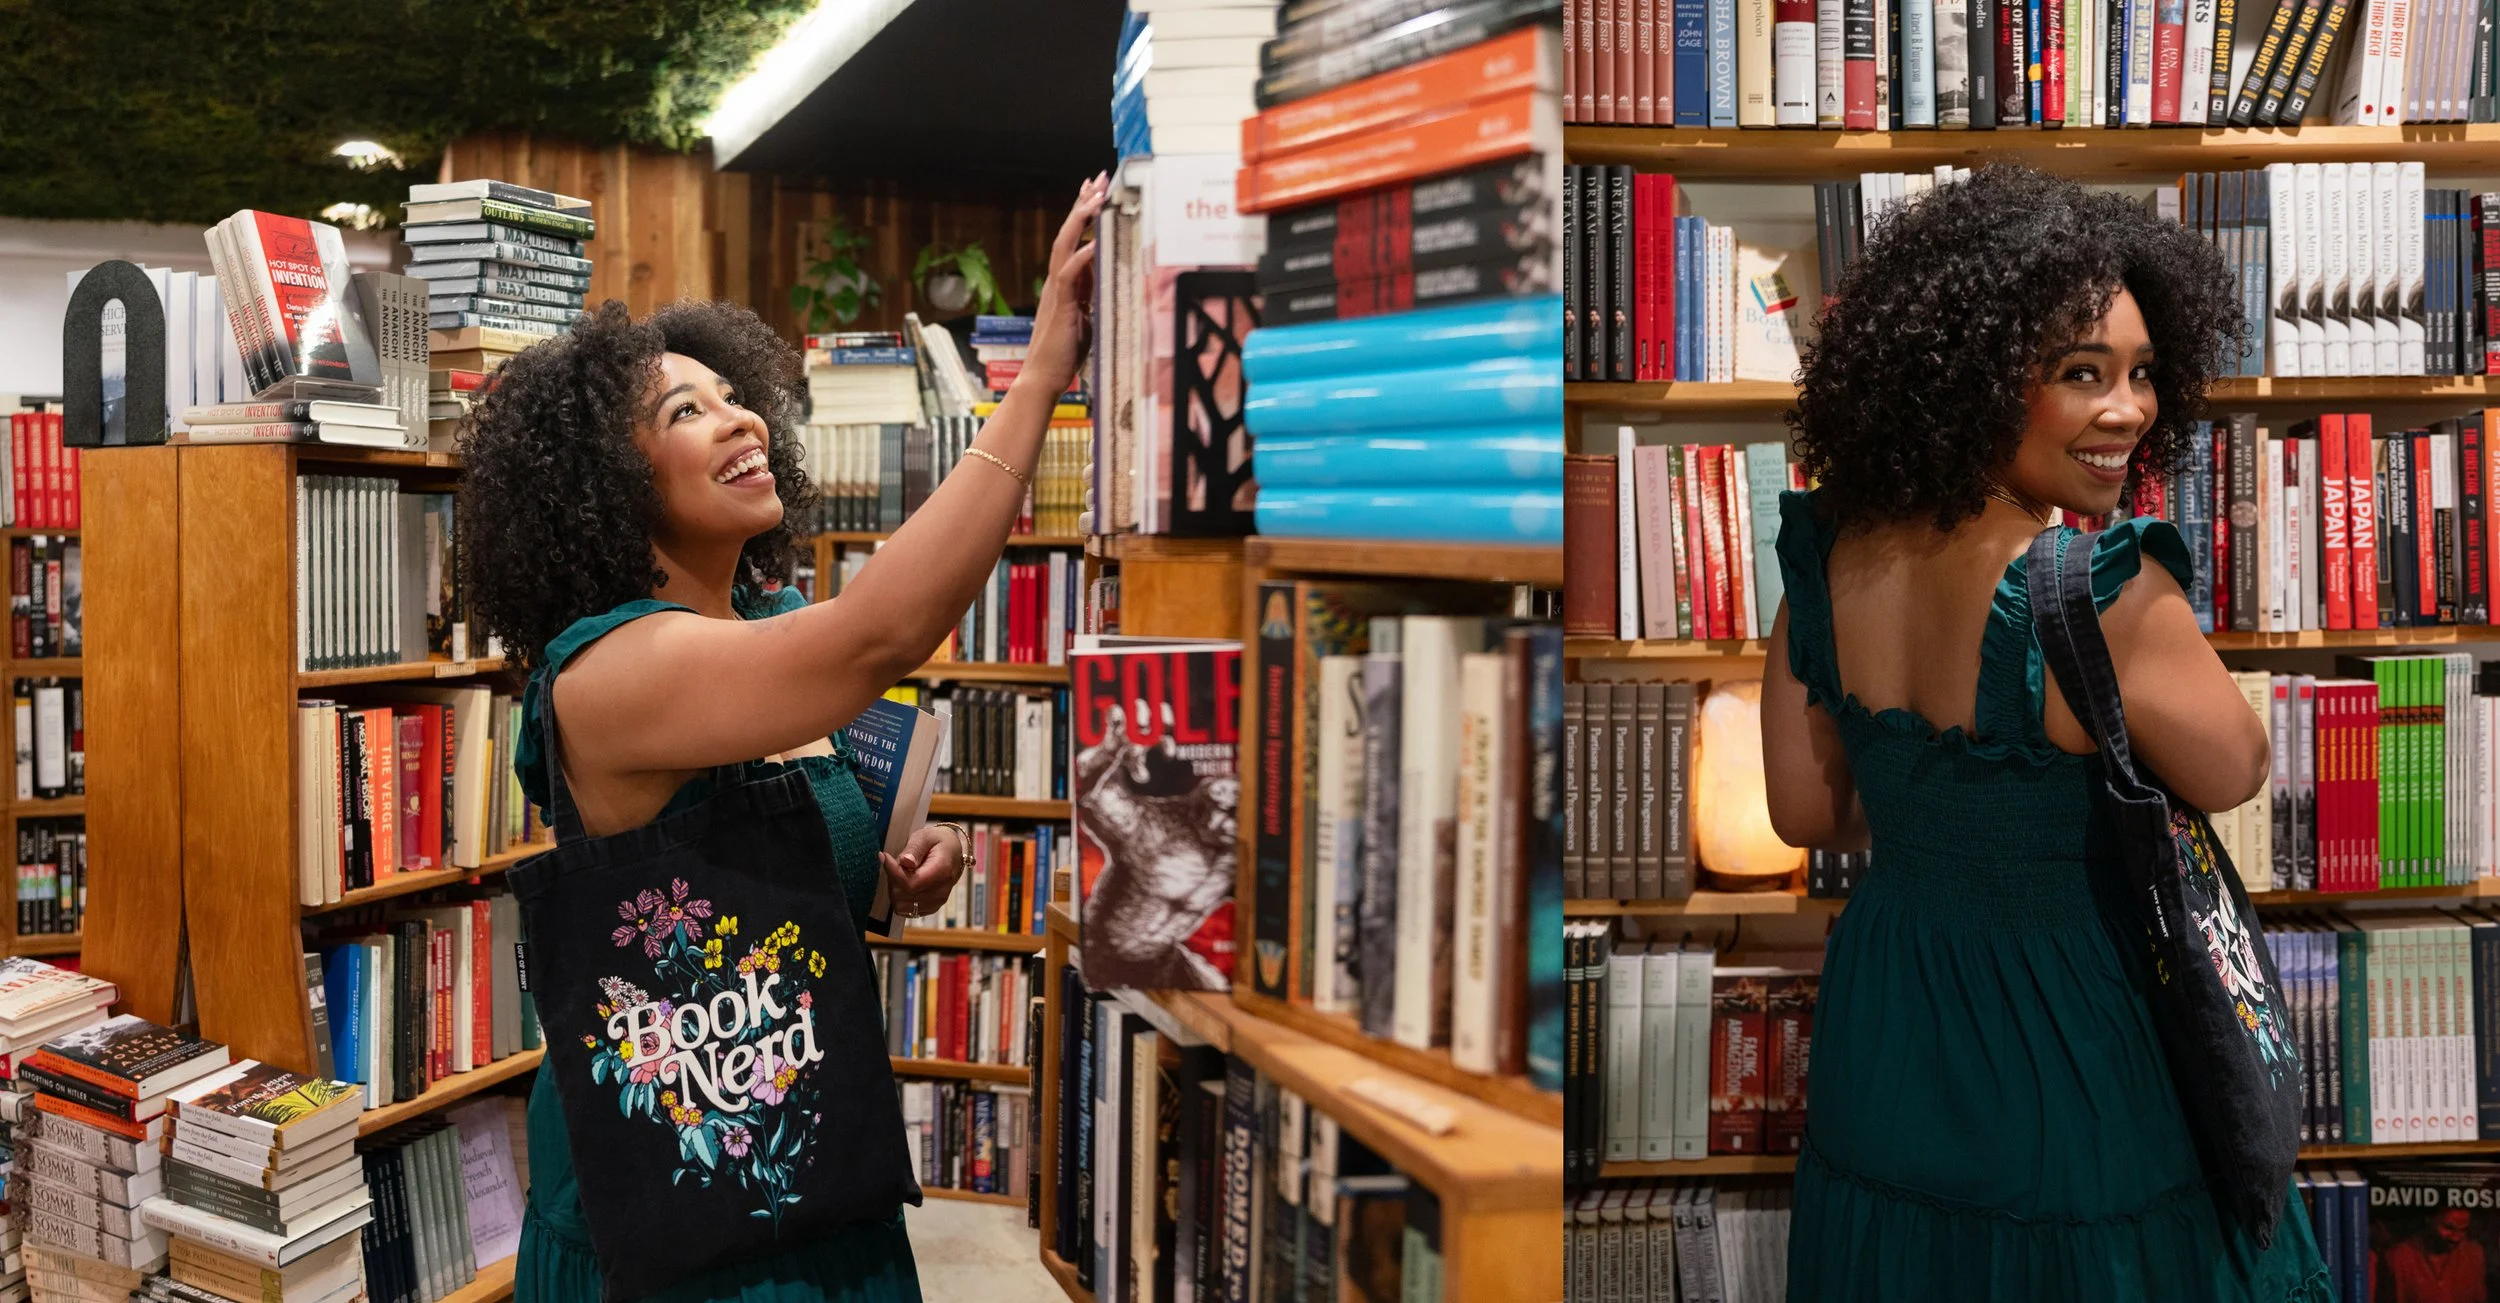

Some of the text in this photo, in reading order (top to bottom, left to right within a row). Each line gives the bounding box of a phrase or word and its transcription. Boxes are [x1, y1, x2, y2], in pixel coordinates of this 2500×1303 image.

[1677, 29, 1702, 38] JOHN
[1911, 13, 1923, 36] Ernest
[2049, 9, 2060, 29] Hell
[2067, 6, 2076, 26] Idea
[2368, 0, 2386, 57] THIRD REICH
[2389, 2, 2407, 58] THIRD REICH
[1582, 19, 1594, 54] Jesus?
[1617, 19, 1631, 54] Jesus?
[1638, 19, 1652, 55] Jesus?
[1657, 19, 1672, 56] Jesus?
[1677, 38, 1702, 48] CAGE
[2012, 9, 2024, 75] OF LIBERTY
[2048, 29, 2060, 55] before
[2214, 28, 2233, 73] RIGHT?
[2306, 33, 2334, 75] RIGHT?
[1715, 38, 1731, 109] BROWN
[2065, 45, 2076, 69] Party
[2159, 29, 2171, 88] MEACHAM
[2168, 47, 2179, 69] JON
[2257, 34, 2280, 78] RIGHT?
[2065, 70, 2076, 103] System
[484, 207, 525, 223] OUTLAWS
[1186, 199, 1228, 220] the
[1586, 176, 1597, 235] DREAM
[1611, 176, 1623, 235] DREAM
[503, 228, 531, 246] MAX
[2278, 190, 2290, 276] WARNER MIFFLIN
[2331, 189, 2343, 275] WARNER MIFFLIN
[2407, 189, 2420, 275] WARNER MIFFLIN
[268, 259, 323, 275] HOT SPOT OF
[498, 264, 529, 281] MAX
[512, 247, 539, 264] MAX
[272, 269, 327, 291] INVENTION
[229, 309, 252, 361] INVENTION
[241, 302, 264, 354] INVENTION
[255, 294, 278, 347] INVENTION
[381, 304, 389, 361] ANARCHY
[402, 308, 410, 362] ANARCHY
[412, 310, 420, 364] ANARCHY
[244, 405, 284, 418] INVENTION
[252, 424, 293, 438] INVENTION
[2233, 422, 2243, 497] BUT MURDER
[2244, 445, 2253, 497] NOT WAR
[2397, 443, 2406, 471] WEAR
[2464, 427, 2479, 496] THE DIRECTOR
[2388, 439, 2400, 526] CHUCK KLOSTERMAN
[2399, 472, 2407, 488] THE
[2323, 476, 2346, 549] JAPAN
[2351, 476, 2373, 549] JAPAN
[2400, 488, 2408, 517] BLACK
[445, 709, 455, 774] ELIZABETH
[848, 727, 897, 752] INSIDE THE
[358, 721, 372, 821] MEDIEVAL HISTORY
[857, 750, 893, 774] NGDOM
[344, 768, 352, 820] CONQUEROR
[381, 745, 392, 833] THE VERGE
[1668, 726, 1683, 852] Partisans and Progressives
[2158, 916, 2170, 939] PRINT
[516, 944, 528, 991] OUT OF PRINT
[607, 970, 787, 1068] Book
[102, 1033, 154, 1056] THEY
[121, 1038, 187, 1068] ALONE
[659, 1008, 825, 1114] Nerd
[1727, 1018, 1743, 1097] ARMAGEDDON
[1743, 1036, 1758, 1077] FACING
[145, 1054, 188, 1076] CHARLES
[261, 1072, 293, 1089] letters
[1079, 1040, 1093, 1115] Ordinary
[20, 1069, 89, 1102] REPORTING ON HITLER
[227, 1097, 253, 1114] from
[252, 1090, 271, 1103] the
[44, 1121, 85, 1145] SOMME
[36, 1151, 78, 1177] SOMME
[34, 1186, 77, 1212] SOMME
[467, 1178, 509, 1201] Alexander
[1230, 1125, 1252, 1268] DOOMED
[2370, 1186, 2440, 1207] DAVID
[175, 1244, 219, 1267] TOM PAULIN
